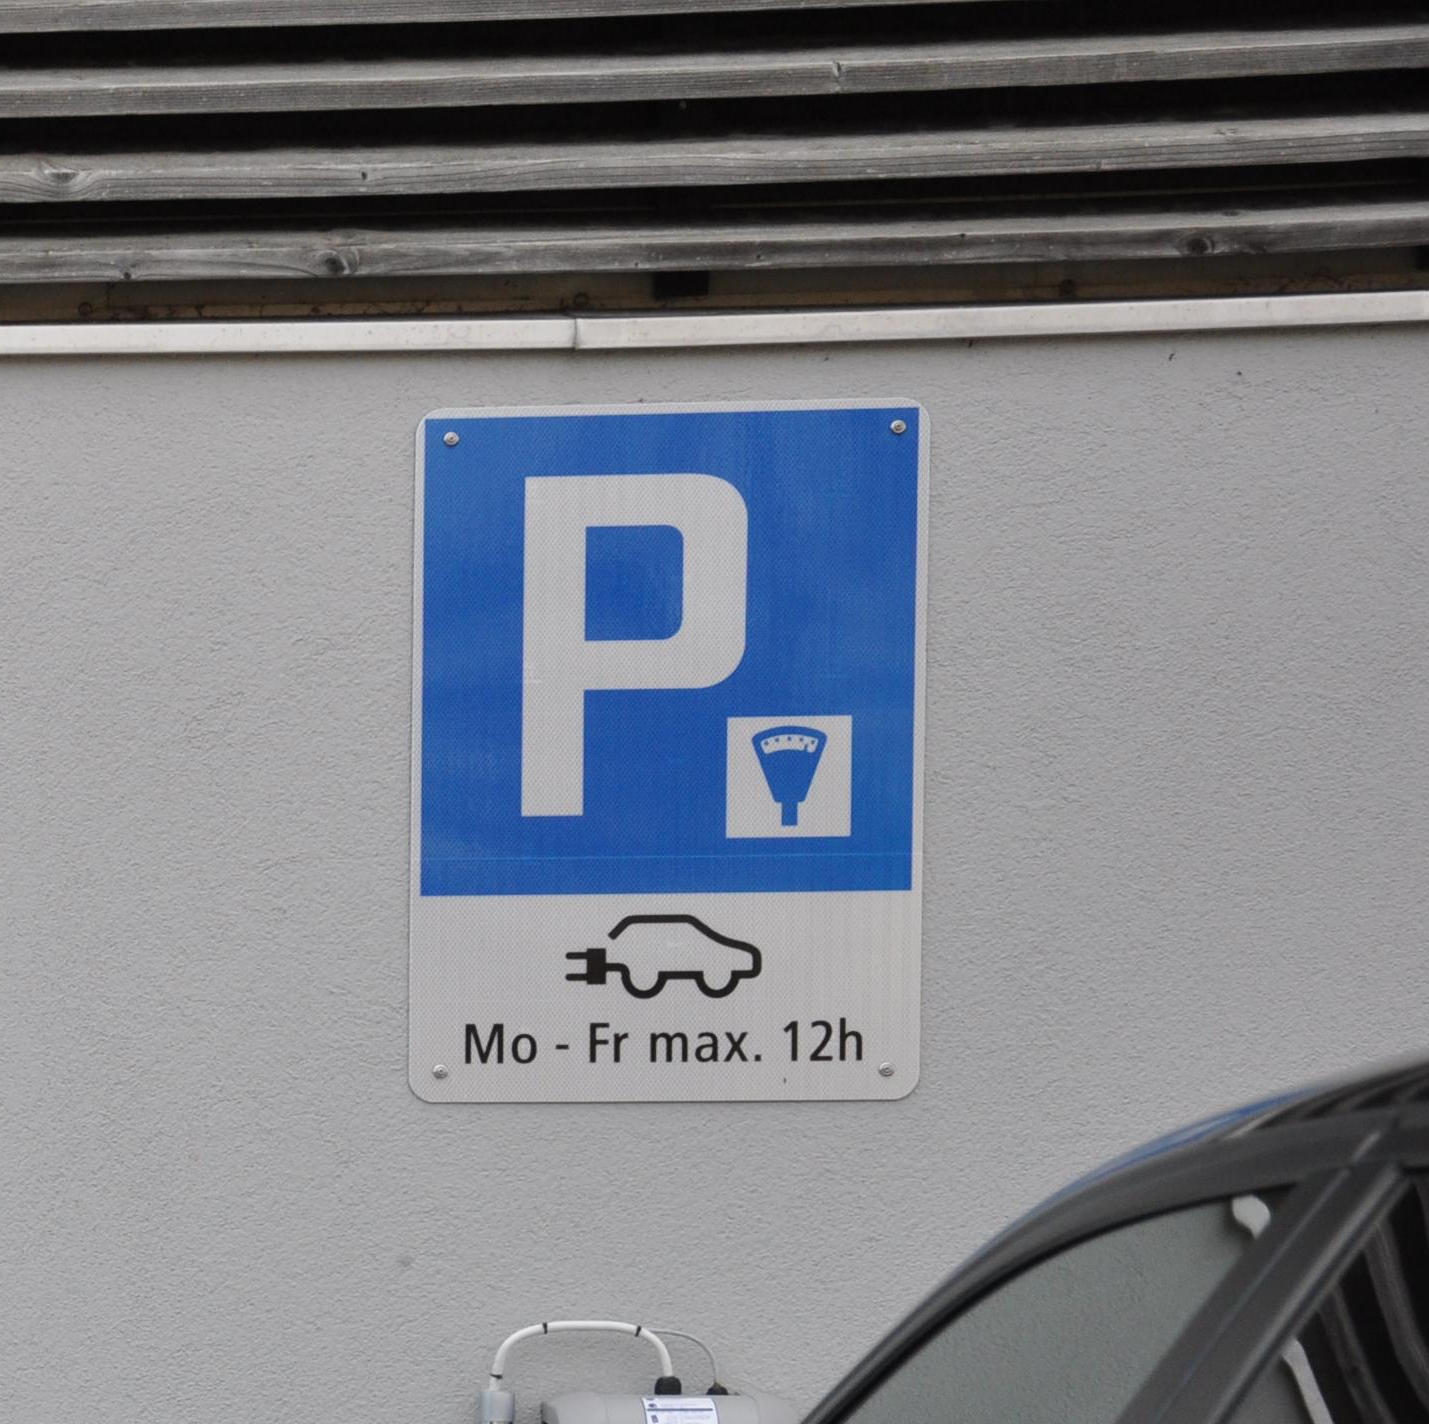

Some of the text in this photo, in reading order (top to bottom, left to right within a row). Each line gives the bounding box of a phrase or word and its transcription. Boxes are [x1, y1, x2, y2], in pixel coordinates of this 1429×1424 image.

[520, 472, 748, 817] P
[464, 1023, 538, 1065] Mo
[589, 1022, 629, 1064] Fr
[649, 1031, 762, 1063] max.
[783, 1017, 863, 1062] 12h
